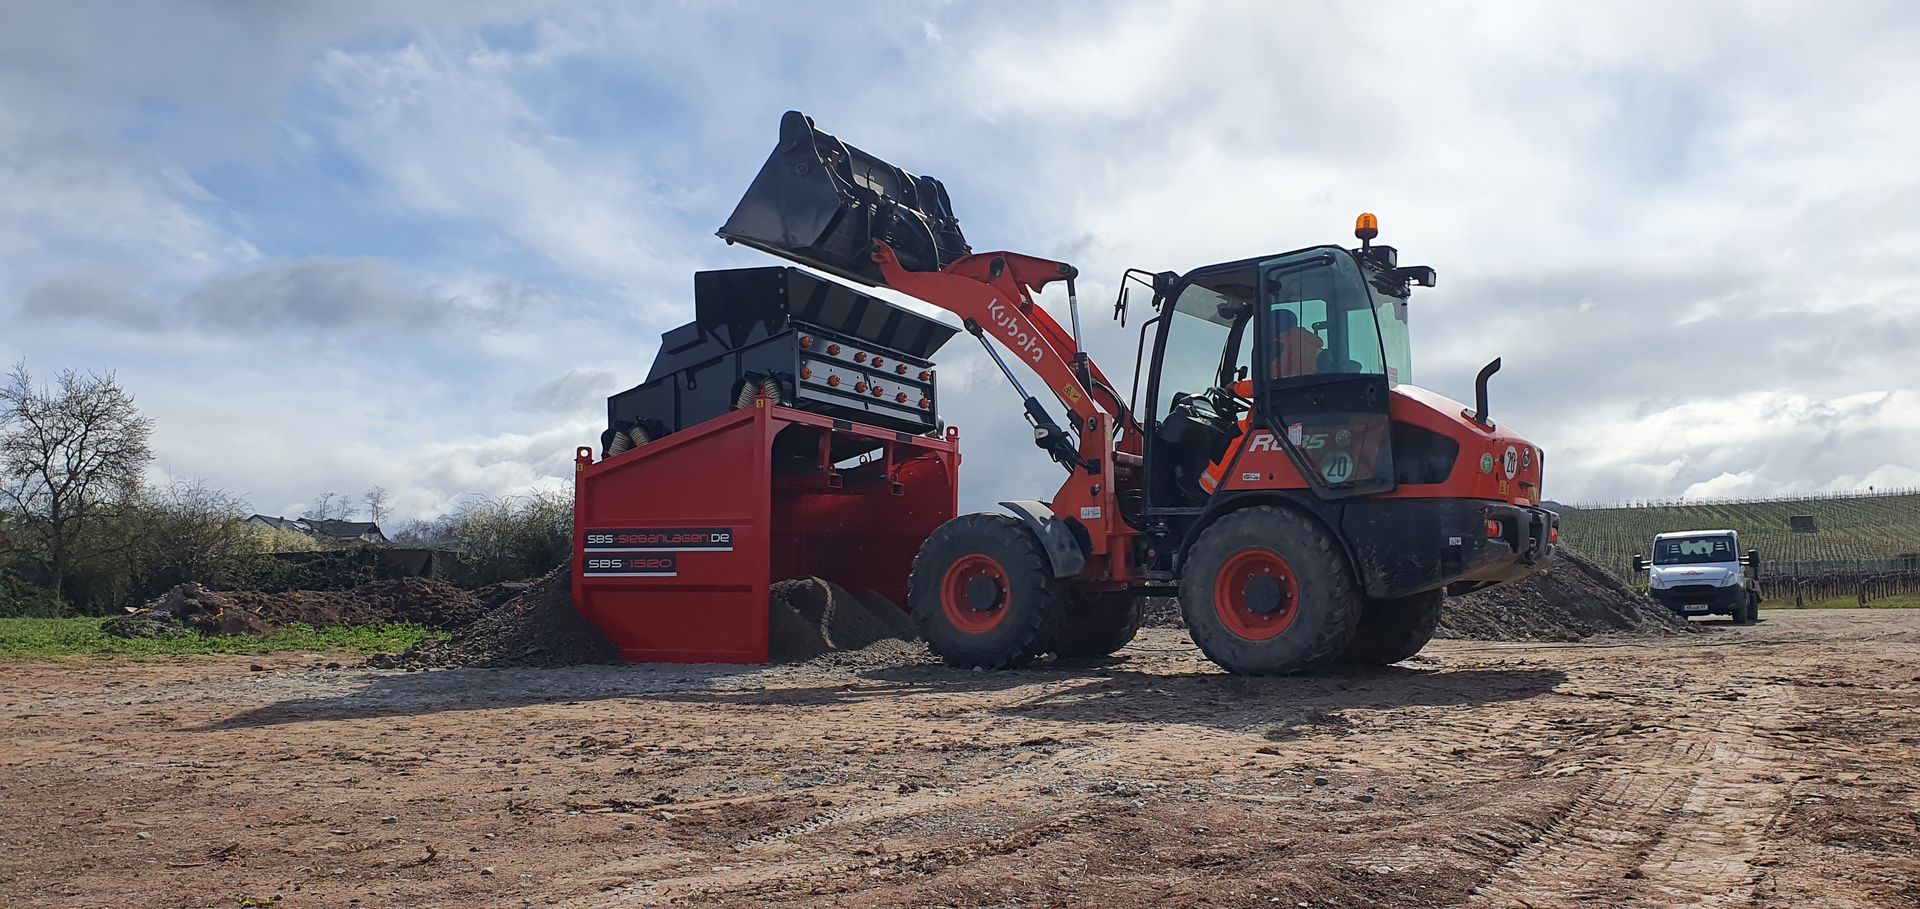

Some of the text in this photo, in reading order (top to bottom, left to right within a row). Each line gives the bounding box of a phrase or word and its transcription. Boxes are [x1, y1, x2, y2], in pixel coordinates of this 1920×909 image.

[987, 297, 1044, 363] Kubota
[1326, 456, 1348, 478] 20
[1506, 451, 1516, 474] 20
